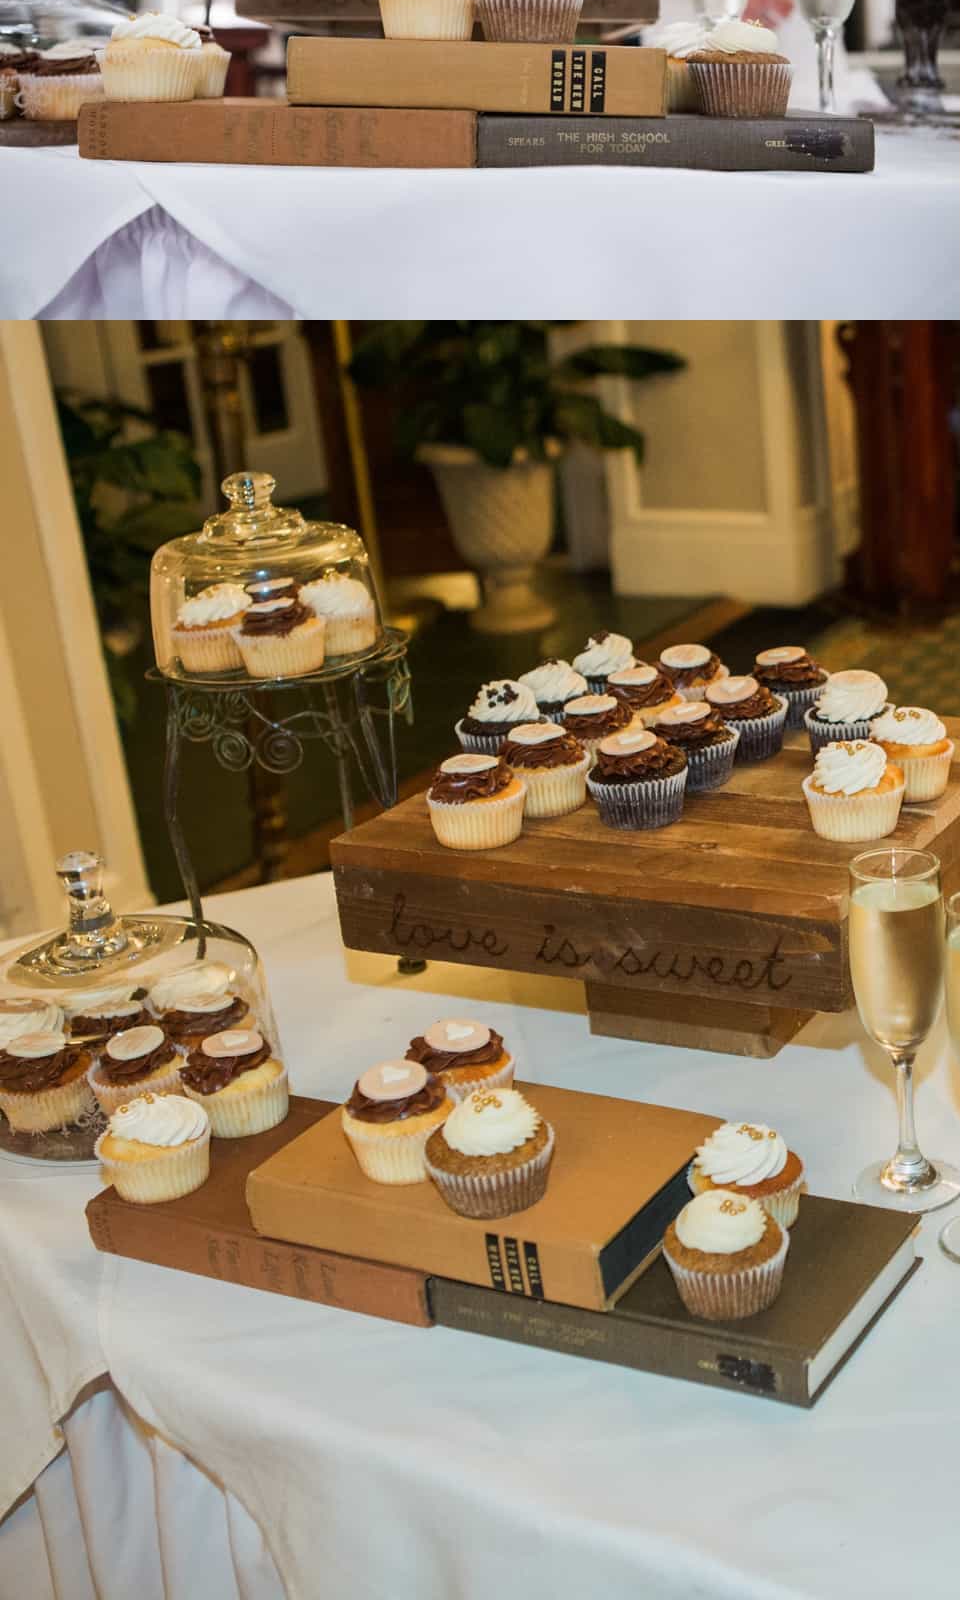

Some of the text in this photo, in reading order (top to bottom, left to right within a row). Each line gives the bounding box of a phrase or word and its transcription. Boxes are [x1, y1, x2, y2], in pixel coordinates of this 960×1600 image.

[552, 61, 564, 102] WORLD
[571, 55, 584, 109] THE NEW
[592, 67, 604, 99] CALL
[556, 131, 672, 145] THE HIGH SCHOOL
[579, 143, 648, 153] FOR TODAY
[387, 893, 794, 992] love is sweet
